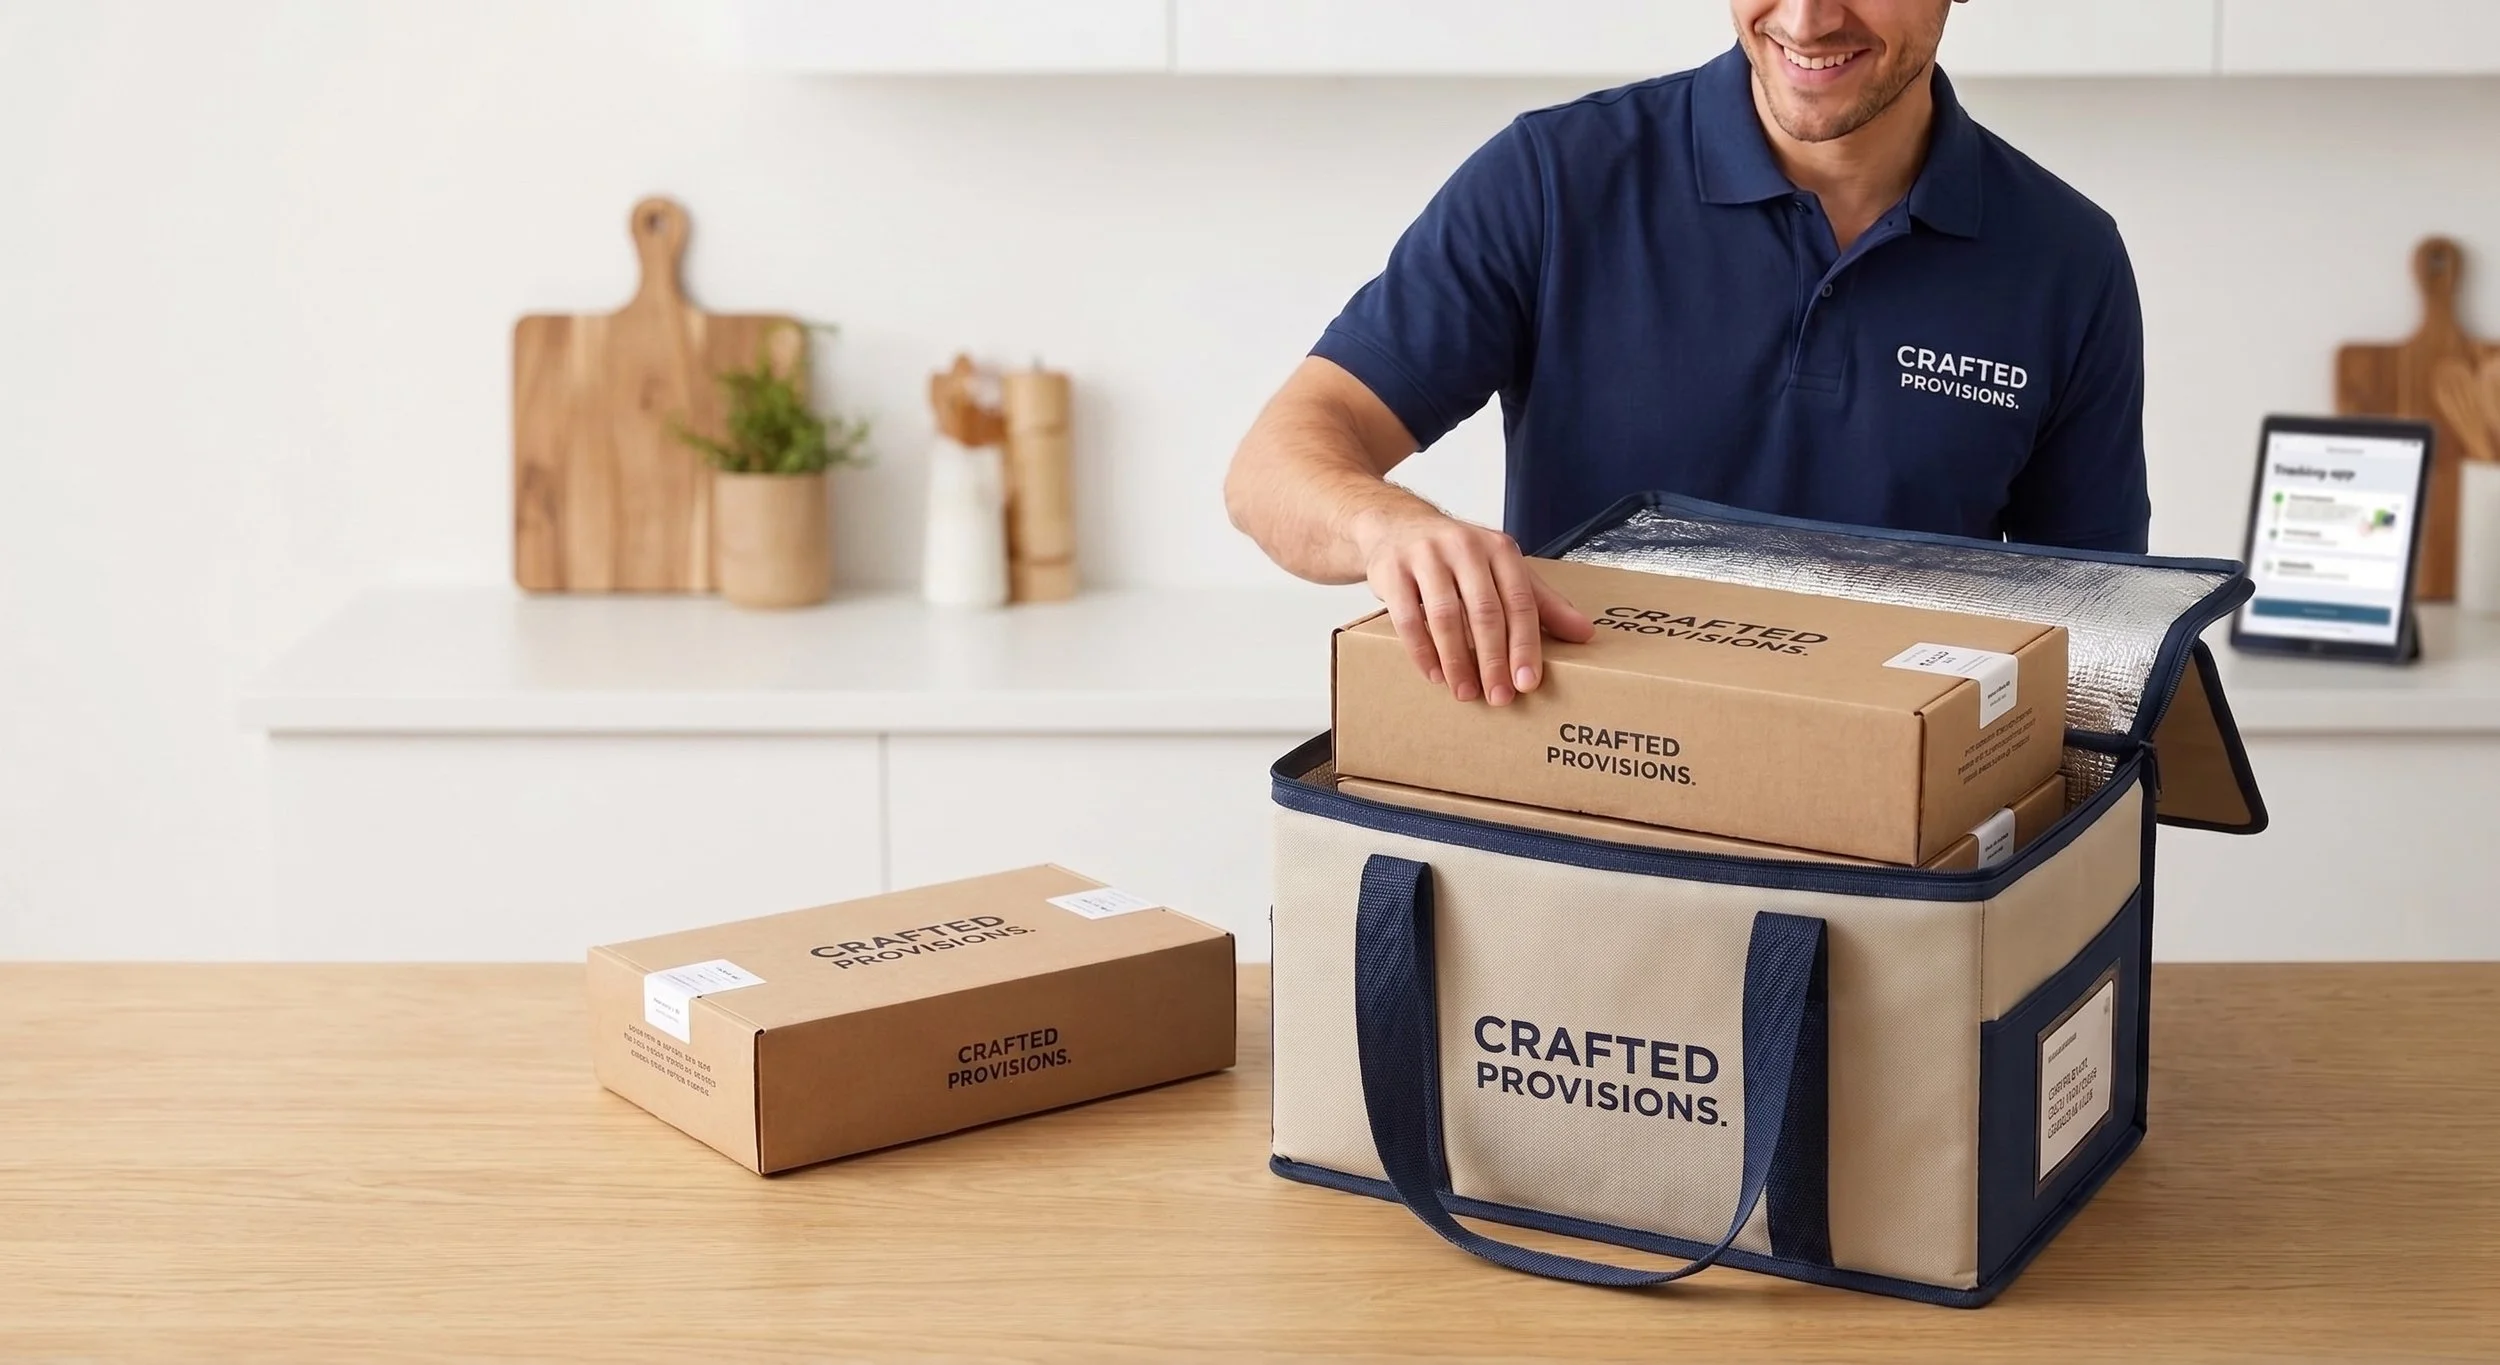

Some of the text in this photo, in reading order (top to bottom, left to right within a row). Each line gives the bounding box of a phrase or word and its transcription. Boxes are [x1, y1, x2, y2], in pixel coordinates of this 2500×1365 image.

[1897, 345, 2028, 389] CRAFTED
[1900, 372, 2019, 410] PROVISIONS.
[1592, 618, 1808, 656] PROVISIONS.
[1604, 606, 1829, 644] CRAFTED
[1559, 723, 1680, 758] CRAFTED
[1547, 746, 1697, 787] PROVISIONS.
[810, 916, 1005, 959] CRAFTED
[832, 925, 1036, 969] PROVISIONS.
[957, 1027, 1059, 1065] CRAFTED
[1474, 1015, 1719, 1085] CRAFTED
[947, 1047, 1073, 1090] PROVISIONS.
[1477, 1060, 1728, 1128] PROVISIONS.
